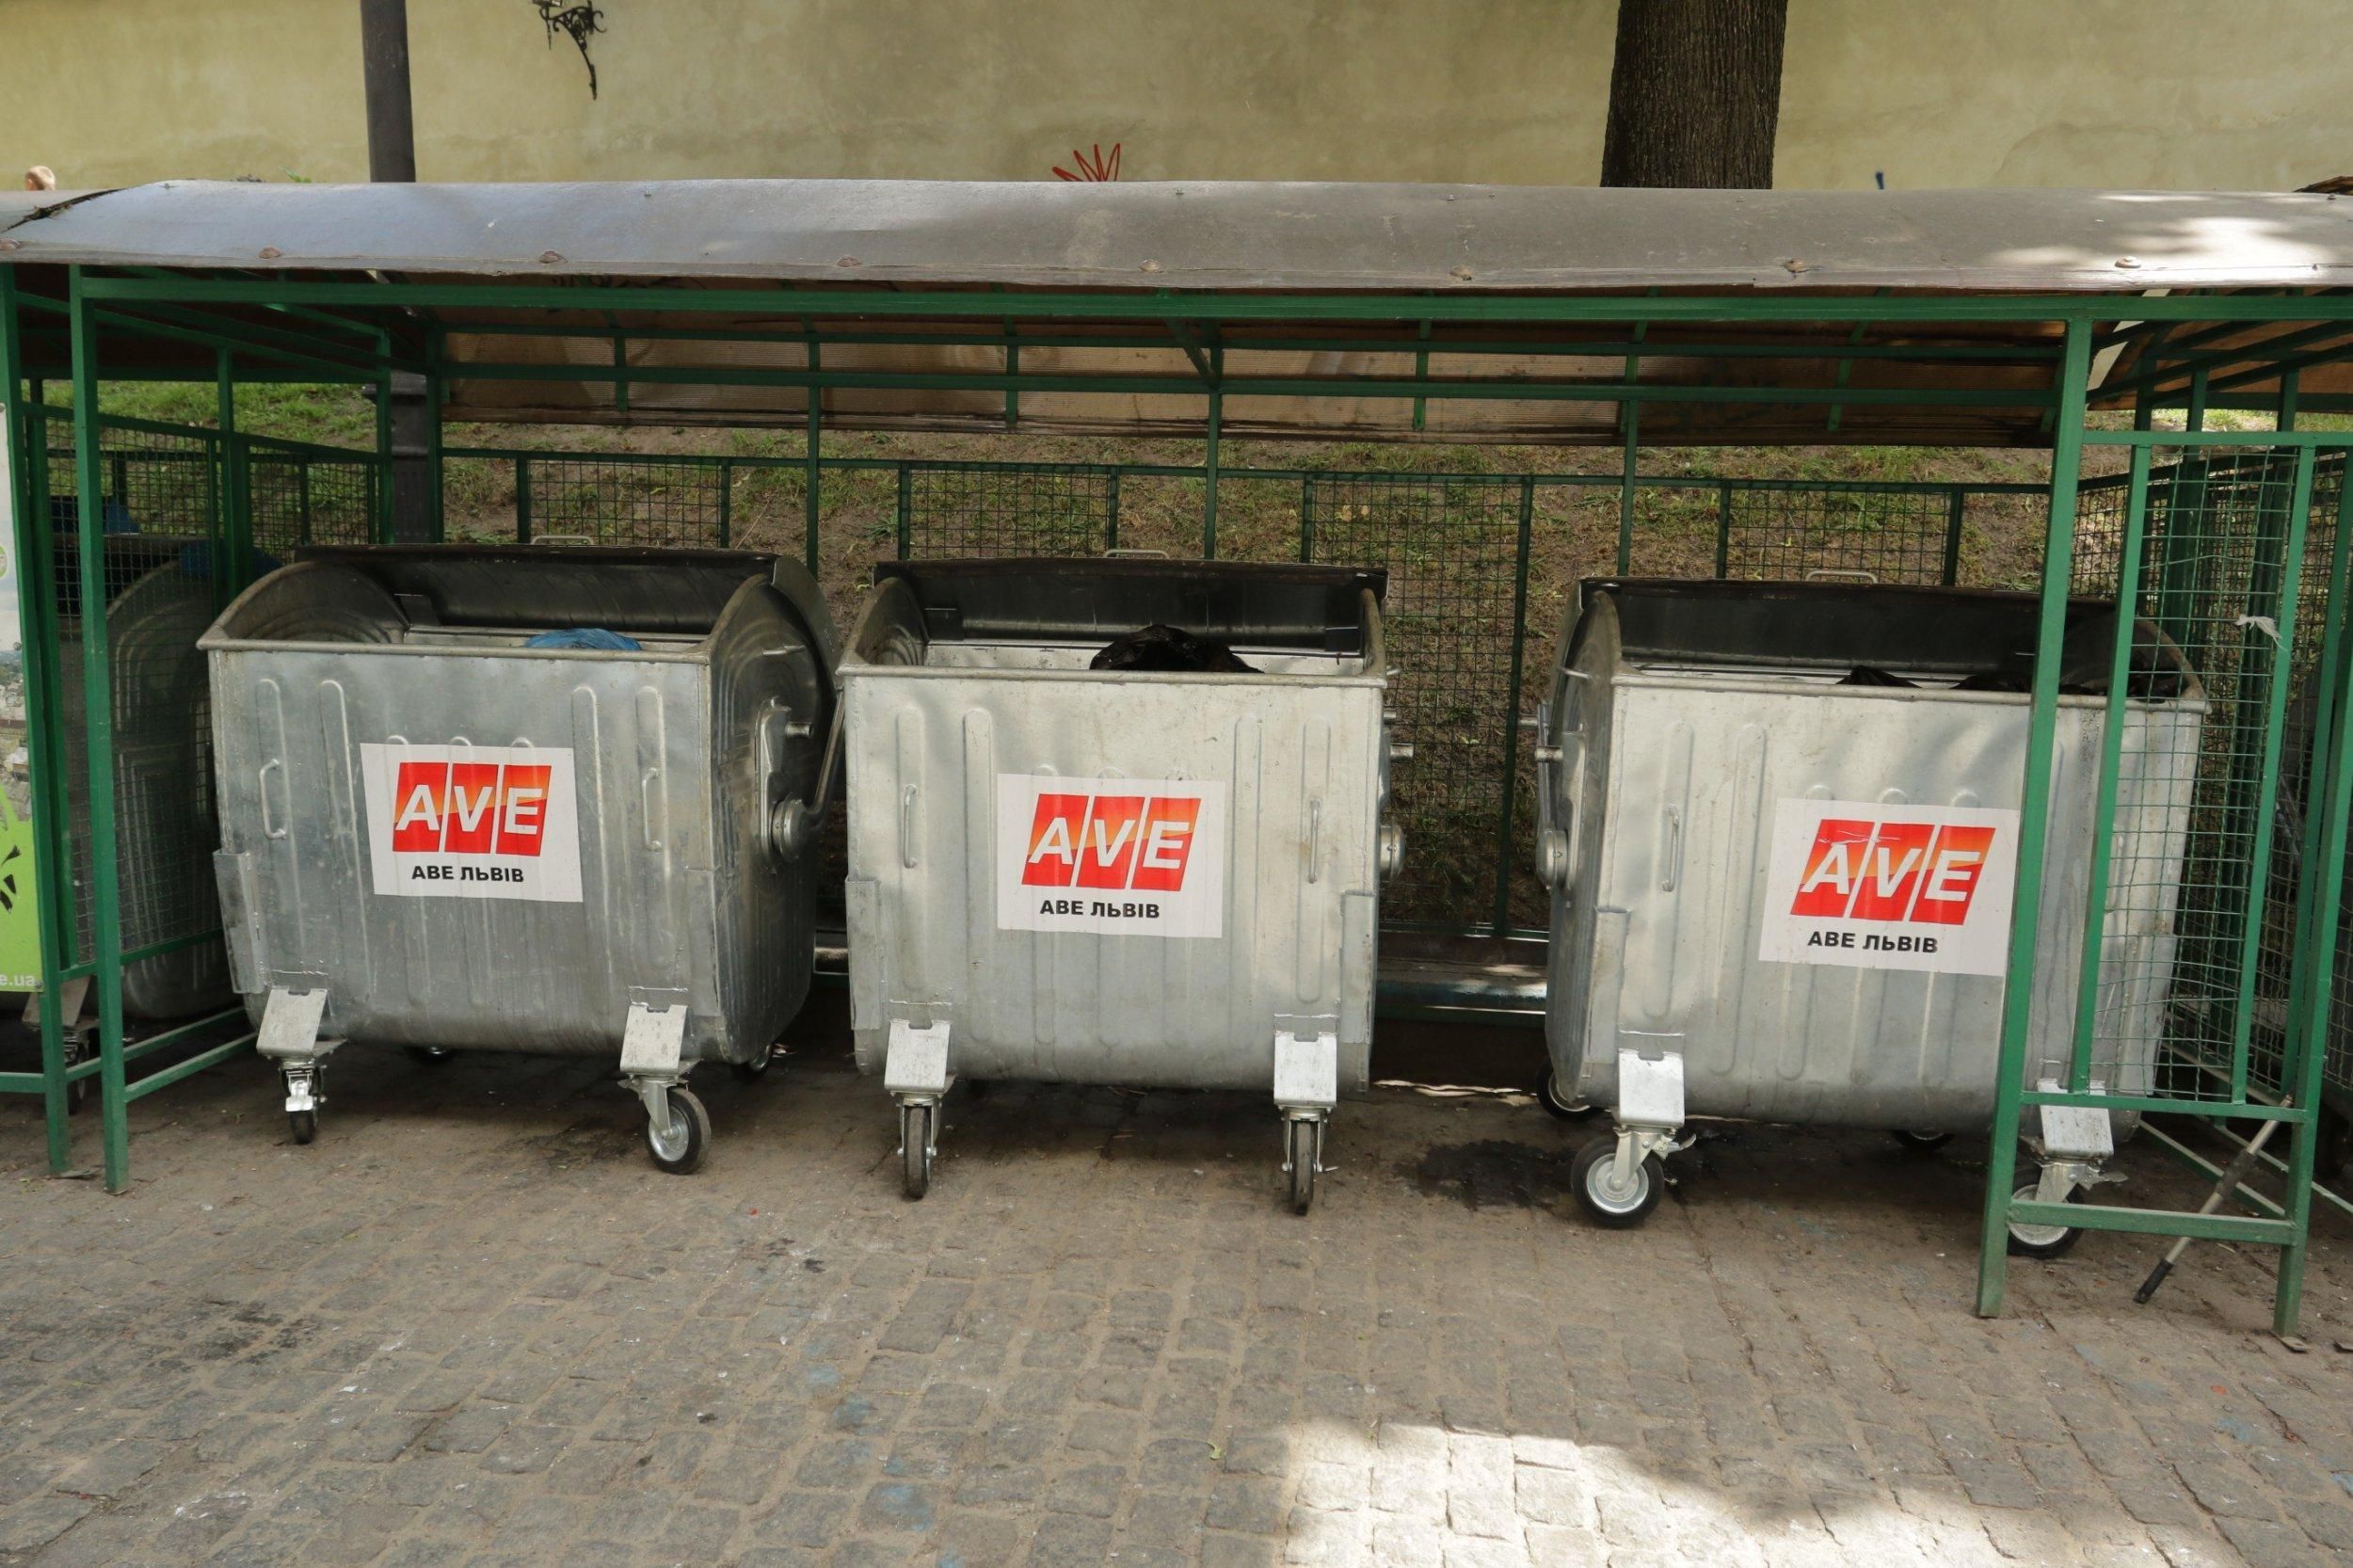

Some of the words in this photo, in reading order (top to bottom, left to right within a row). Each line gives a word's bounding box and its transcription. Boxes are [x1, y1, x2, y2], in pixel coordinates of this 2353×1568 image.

[395, 785, 543, 835] AVE
[1028, 817, 1190, 869] AVE
[411, 865, 454, 880] АВЕ
[460, 867, 524, 882] ЛЬВІВ
[1800, 843, 1980, 902] AVE
[1040, 900, 1083, 916] АВЕ
[1091, 902, 1160, 919] ЛЬВІВ
[1807, 931, 1855, 948] АВЕ
[1862, 935, 1938, 953] ЛЬВІВ
